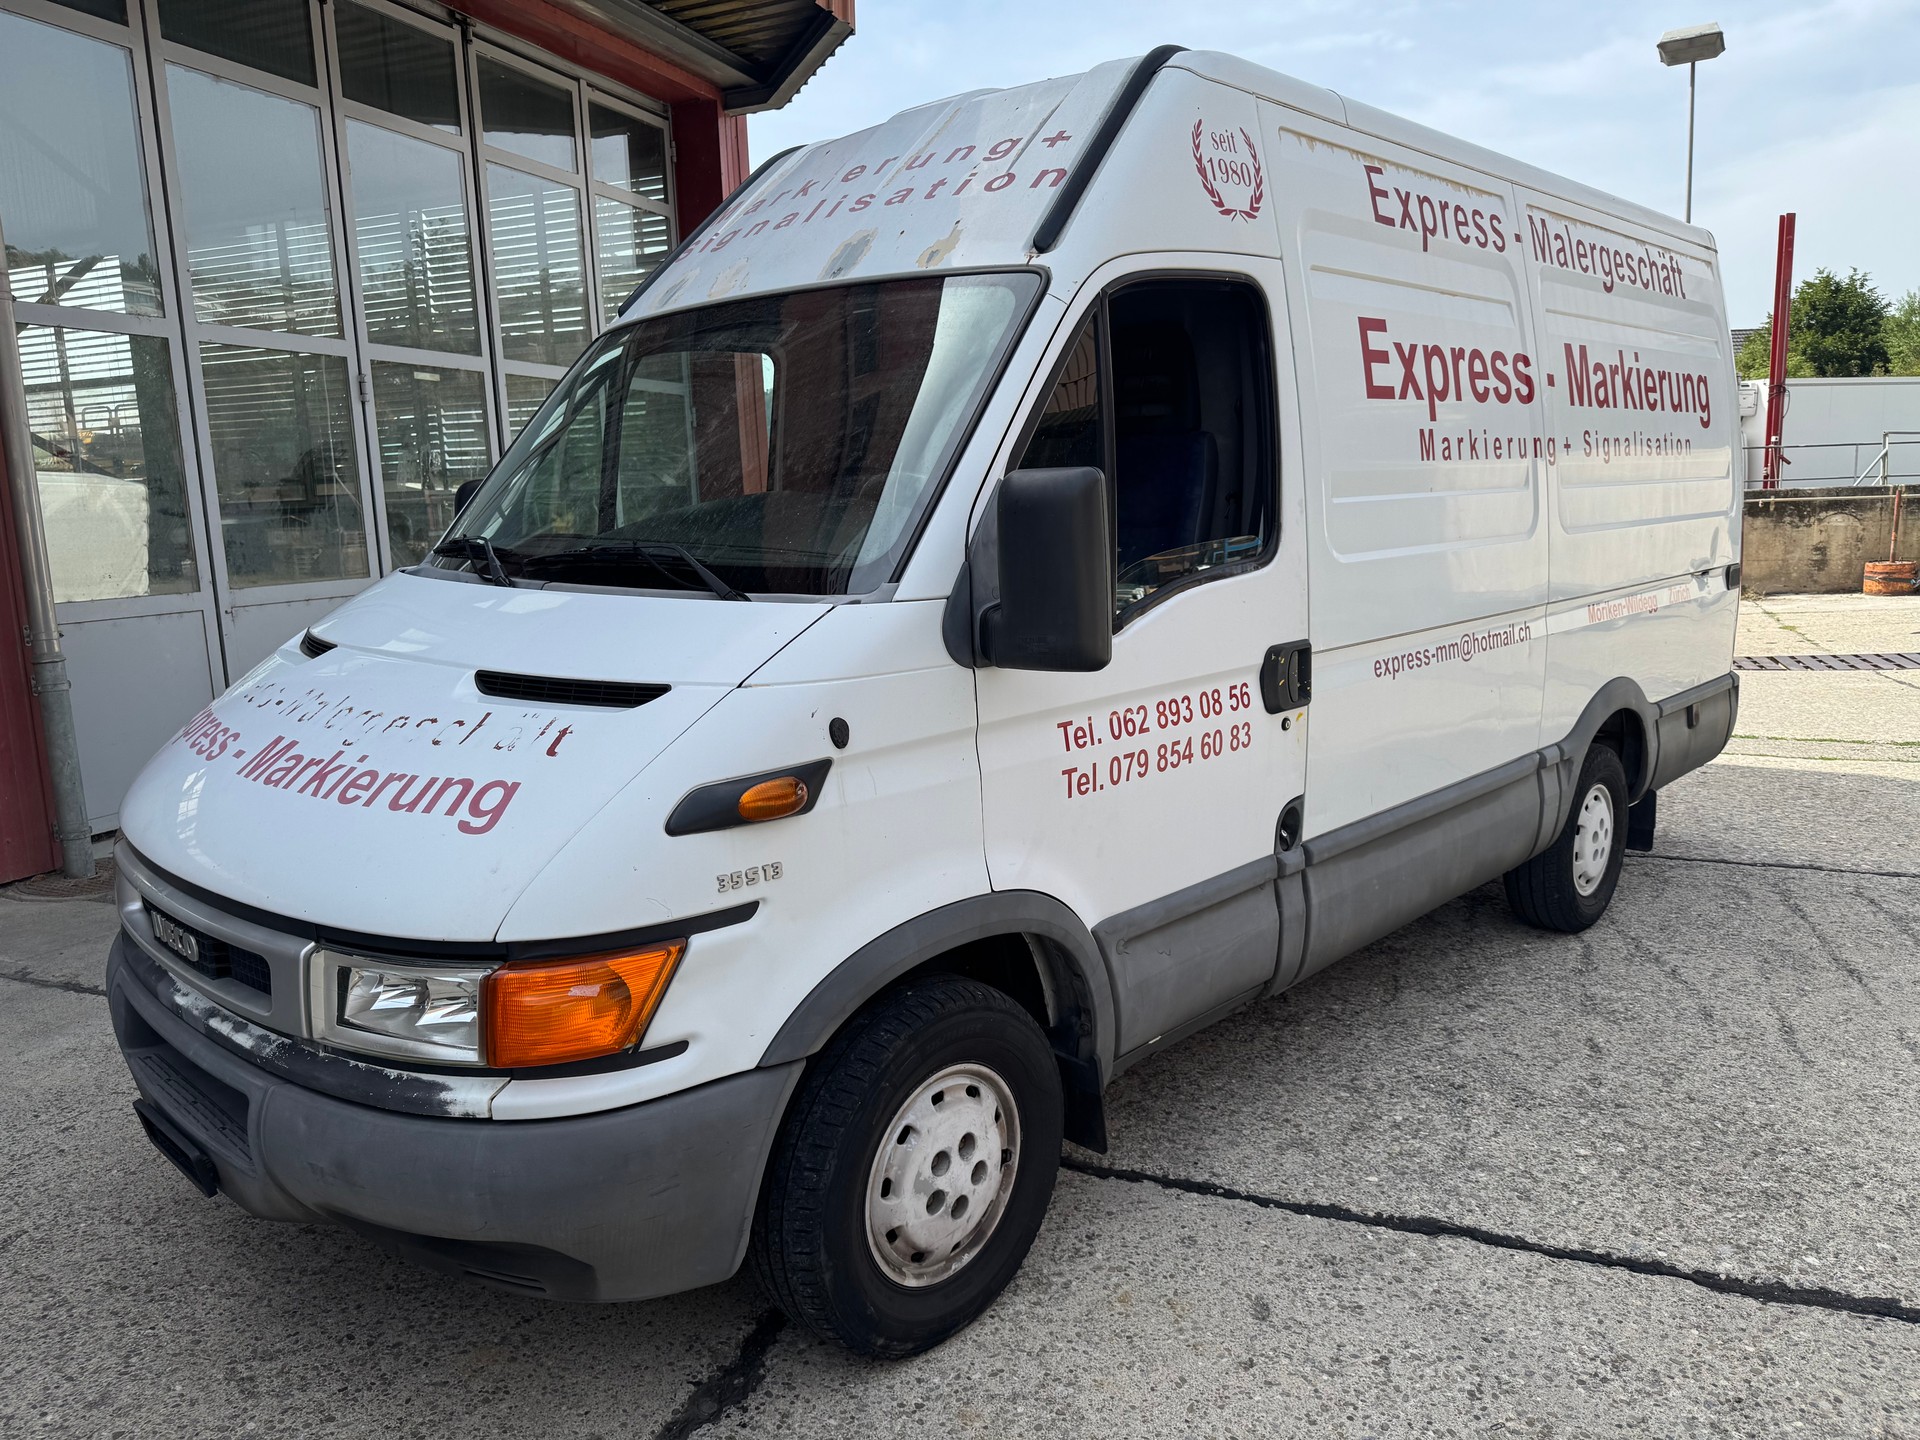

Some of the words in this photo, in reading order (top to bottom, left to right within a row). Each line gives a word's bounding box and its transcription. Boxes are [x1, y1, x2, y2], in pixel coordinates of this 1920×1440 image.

[1041, 129, 1073, 149] +
[1206, 157, 1252, 187] 1980
[1210, 129, 1238, 154] seit
[674, 168, 1068, 264] Signalisation
[1364, 165, 1507, 253] Express
[1527, 214, 1687, 300] Malergeschäft
[1357, 316, 1537, 422] Express
[1563, 342, 1712, 428] Markierung
[1419, 428, 1556, 466] Markierung
[1563, 437, 1572, 456] +
[1583, 429, 1692, 464] Signalisation
[1373, 621, 1531, 680] express-mm@hotmail.ch
[1056, 715, 1103, 752] Tel.
[1109, 704, 1151, 741] 062
[1156, 695, 1195, 730] 893
[1199, 688, 1224, 719] 08
[1229, 682, 1252, 712] 56
[236, 735, 521, 836] Markierung
[1061, 762, 1105, 799] Tel.
[1108, 748, 1150, 786] 079
[1156, 736, 1195, 773] 854
[1200, 728, 1224, 760] 60
[1229, 721, 1252, 752] 83
